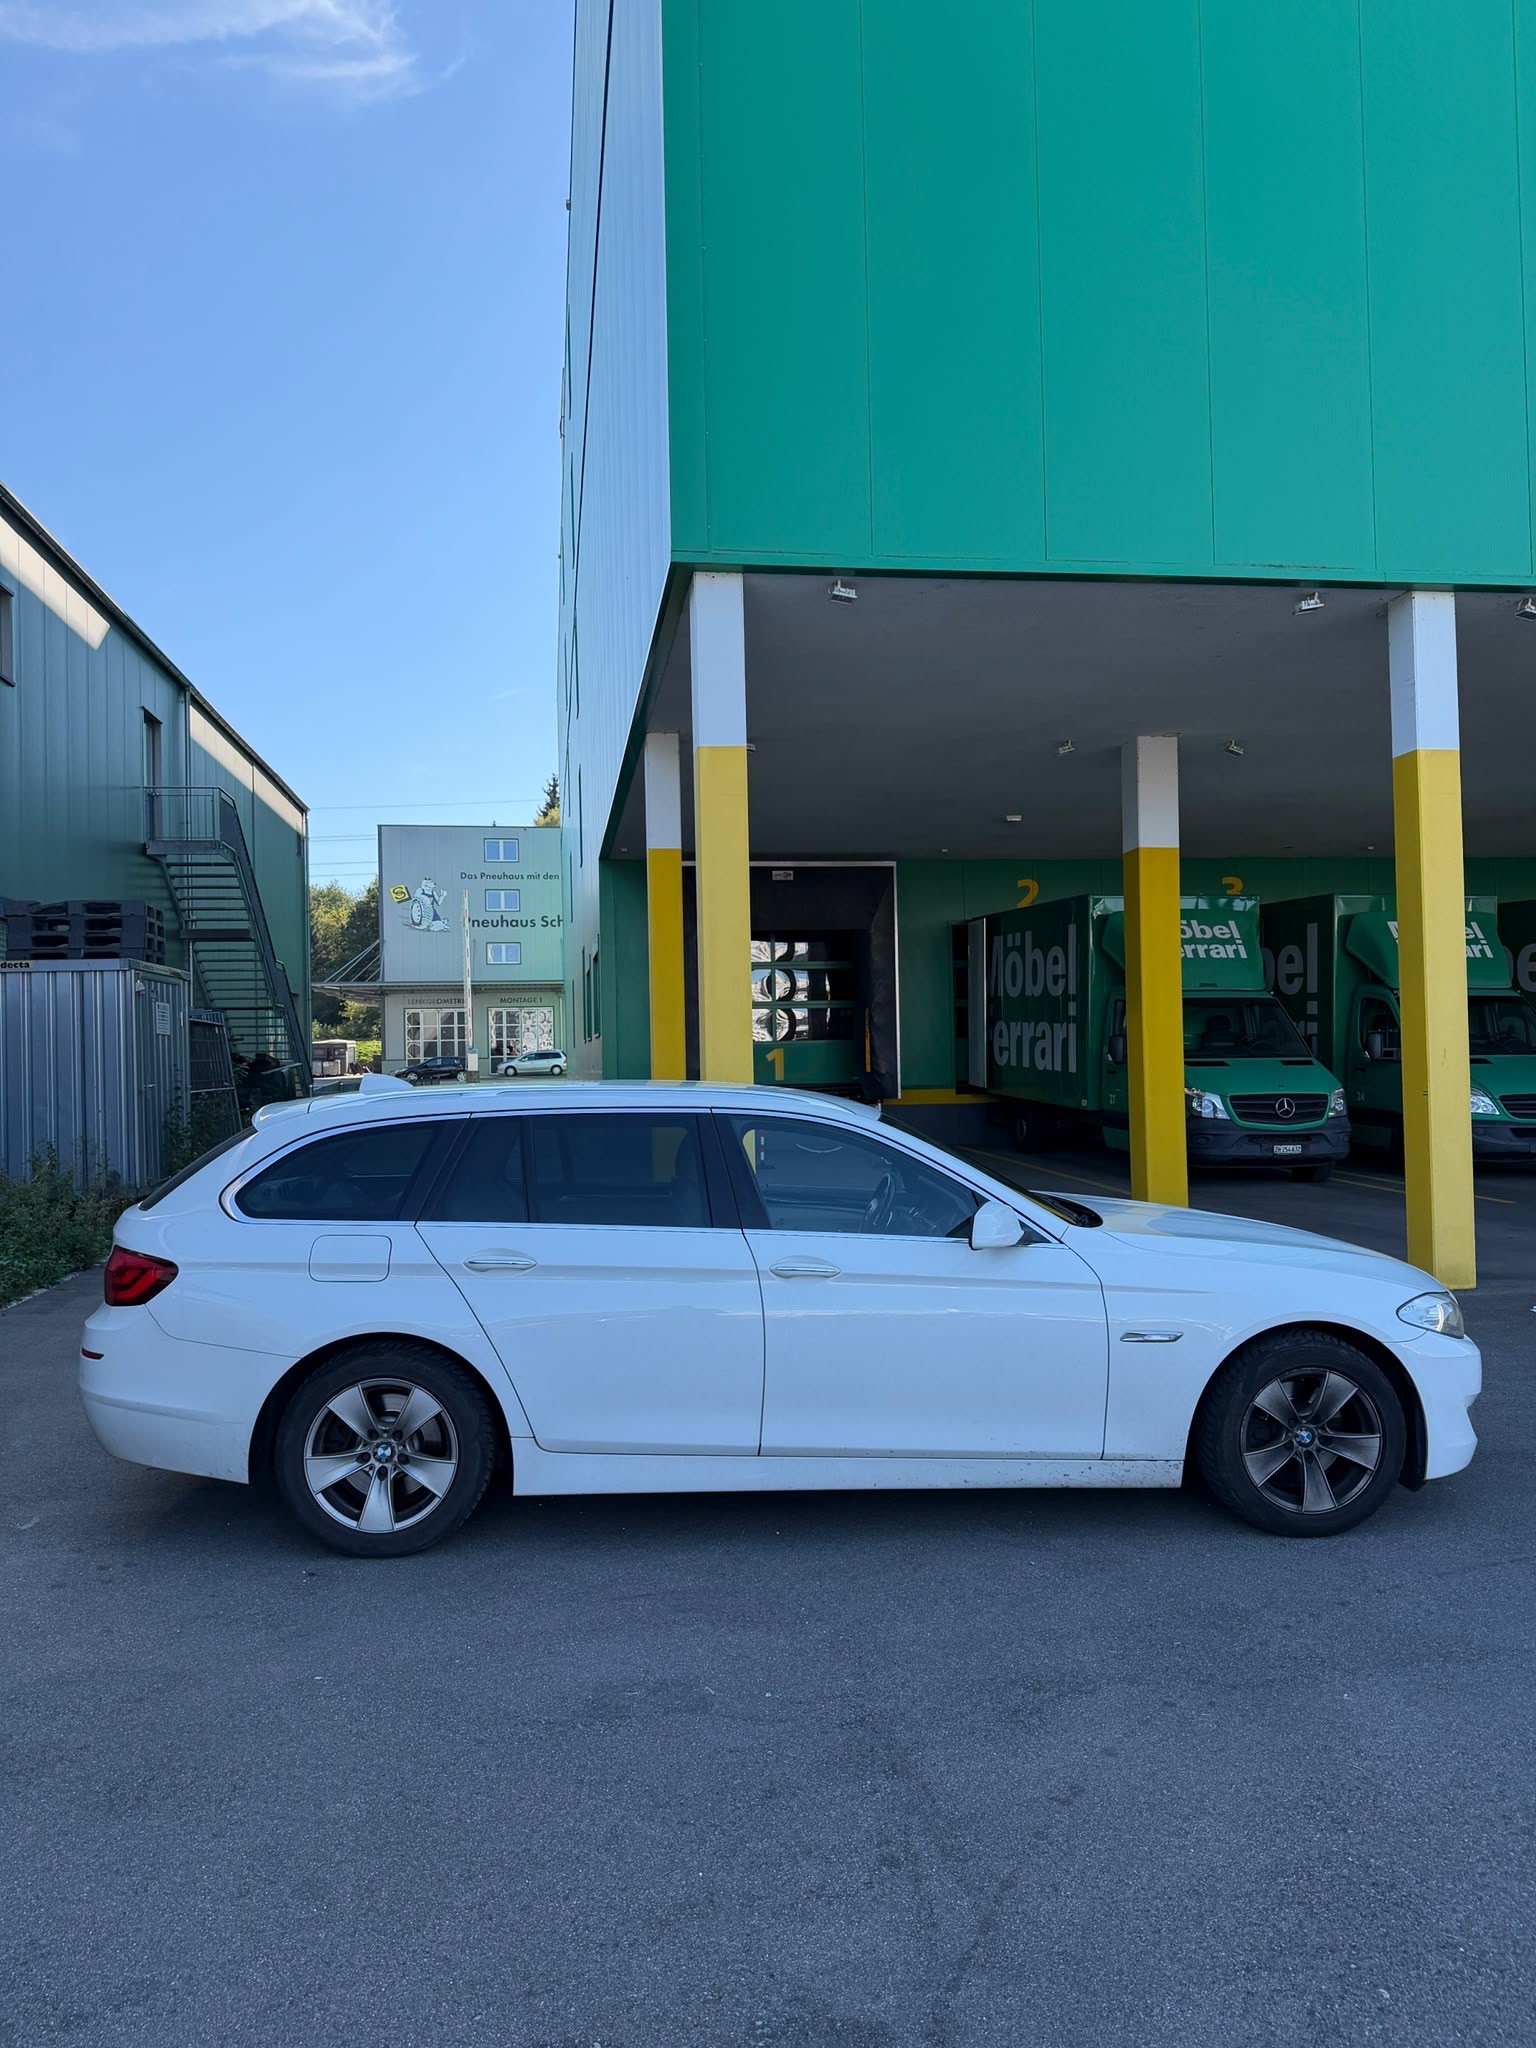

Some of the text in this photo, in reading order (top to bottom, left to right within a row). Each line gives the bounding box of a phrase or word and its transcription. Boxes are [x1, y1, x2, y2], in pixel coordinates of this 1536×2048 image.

[460, 872, 560, 880] Das Pneuhaus mit den
[1017, 879, 1039, 908] 2
[468, 914, 536, 928] neuhaus
[1181, 920, 1241, 938] öbel
[992, 1002, 1077, 1073] errari
[765, 1048, 785, 1080] 1
